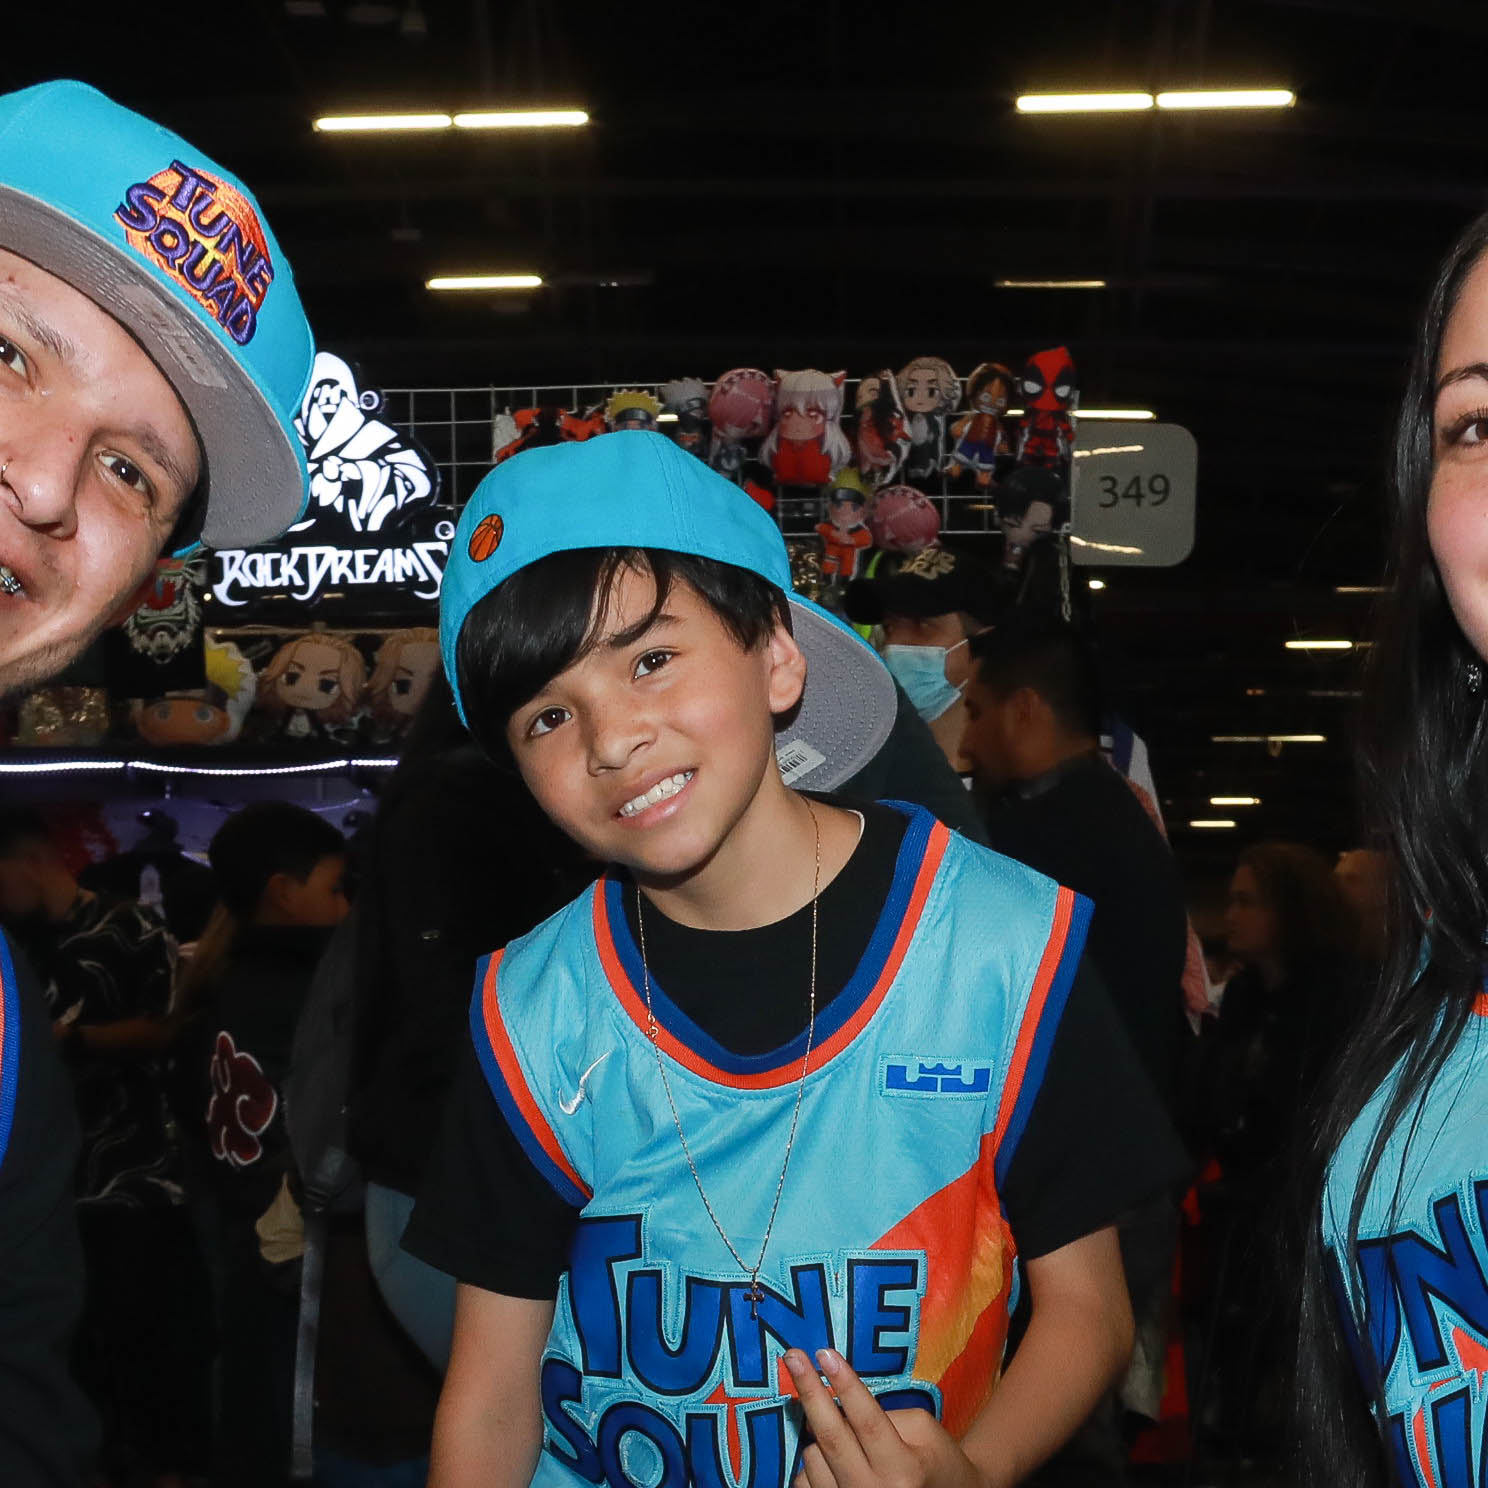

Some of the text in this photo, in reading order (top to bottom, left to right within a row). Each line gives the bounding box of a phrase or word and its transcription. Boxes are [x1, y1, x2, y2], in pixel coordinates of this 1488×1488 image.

[114, 182, 258, 346] SQUAD
[169, 159, 274, 298] TUNE
[1098, 473, 1170, 509] 349
[565, 1214, 920, 1396] TUNE
